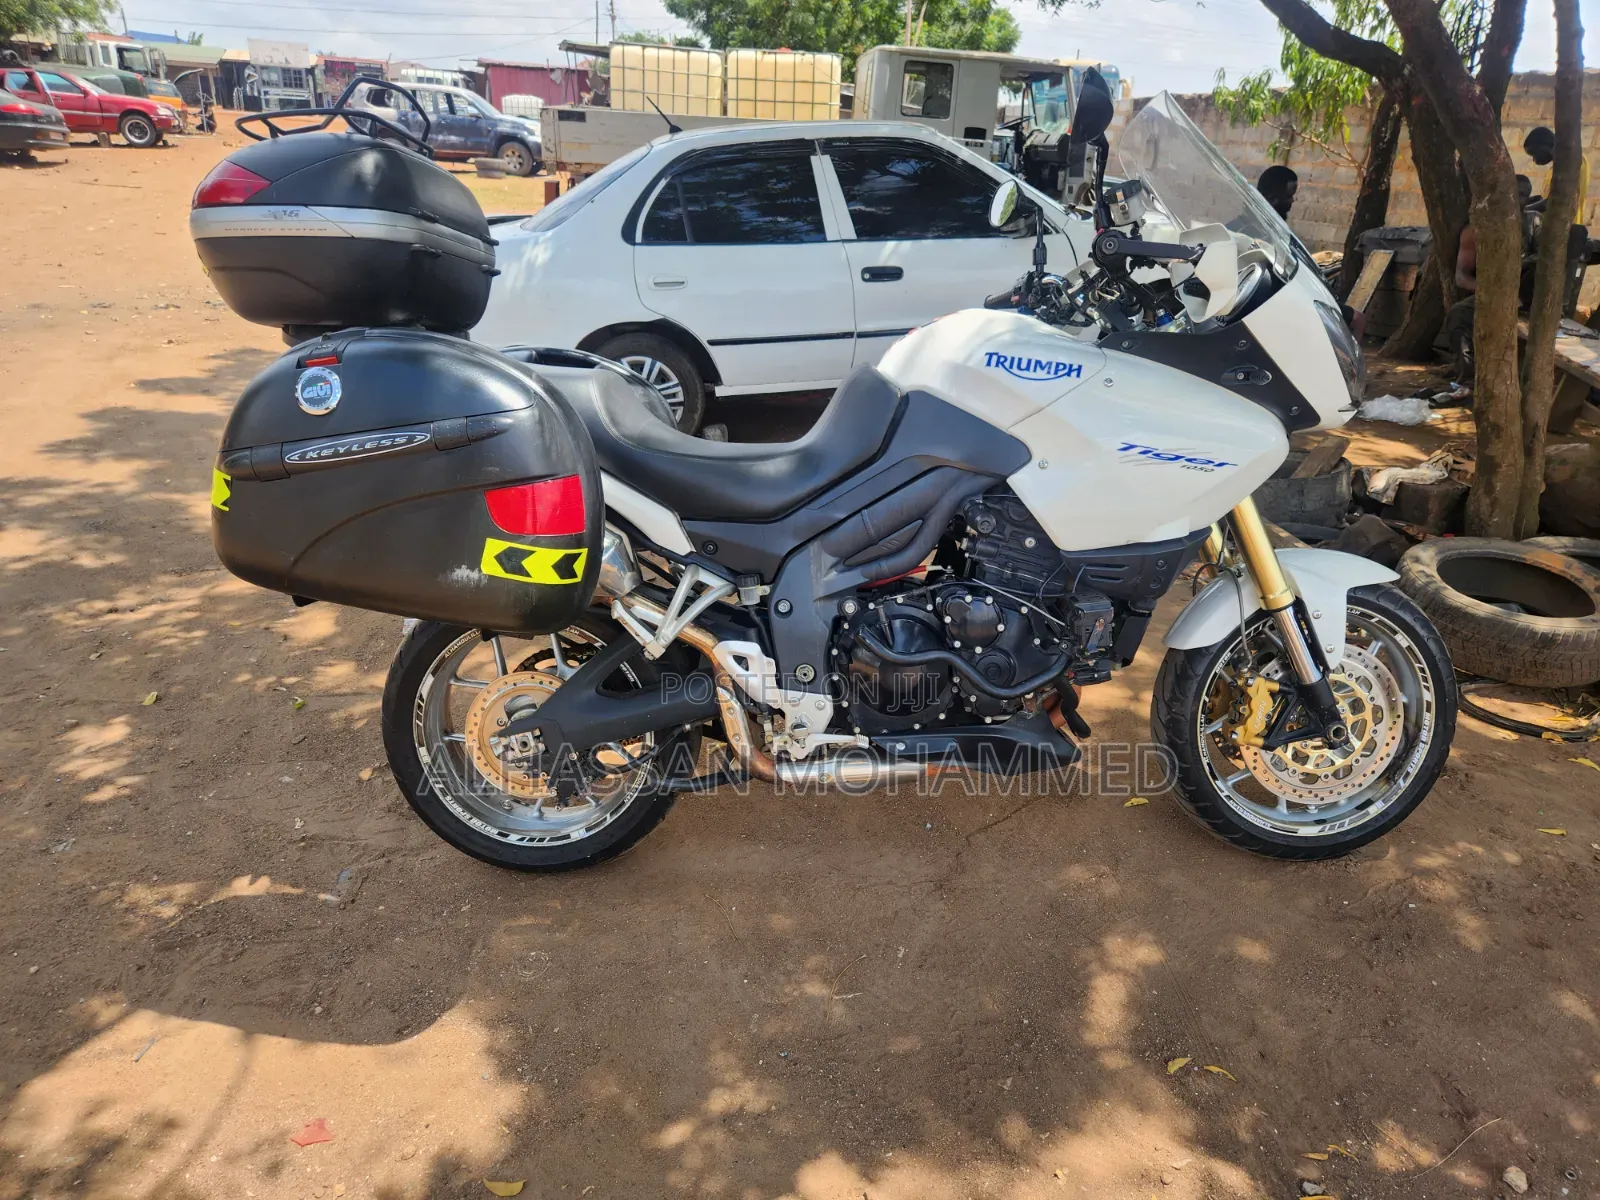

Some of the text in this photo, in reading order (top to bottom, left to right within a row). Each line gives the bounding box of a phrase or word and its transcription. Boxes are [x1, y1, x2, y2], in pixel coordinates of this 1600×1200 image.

[984, 351, 1083, 381] TRIUMPH
[302, 383, 332, 399] GIVI
[305, 435, 409, 460] KEYLESS
[1116, 441, 1239, 468] Tiger
[1180, 464, 1215, 473] 1050
[444, 629, 482, 659] ALHAMDULILL
[1407, 711, 1432, 774] MOTOR SPORTS
[444, 795, 499, 836] MOTOR SPORTS
